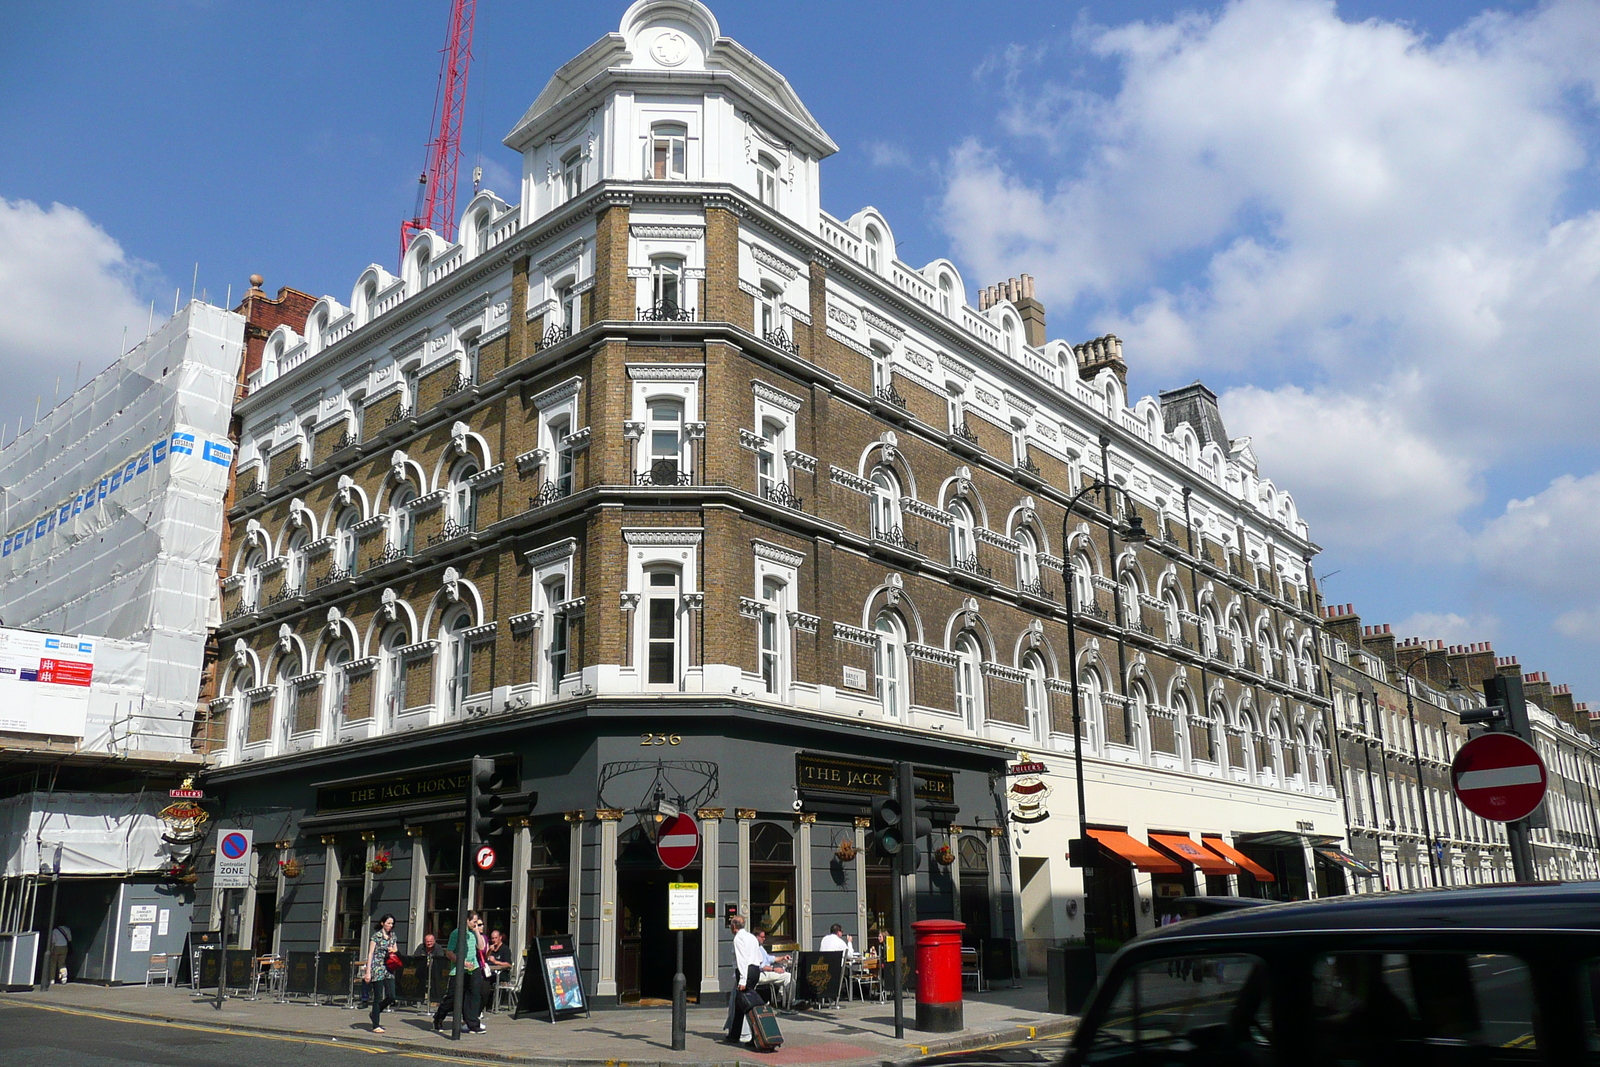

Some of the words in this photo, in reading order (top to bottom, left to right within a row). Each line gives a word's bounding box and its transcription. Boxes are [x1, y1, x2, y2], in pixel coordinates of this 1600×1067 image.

[174, 439, 194, 449] COSTAIN
[60, 641, 78, 650] COSTAIN
[640, 732, 682, 746] 236
[805, 766, 841, 781] THE
[846, 770, 883, 786] JACK
[350, 788, 376, 802] THE
[381, 783, 411, 799] JACK
[220, 867, 245, 875] ZONE
